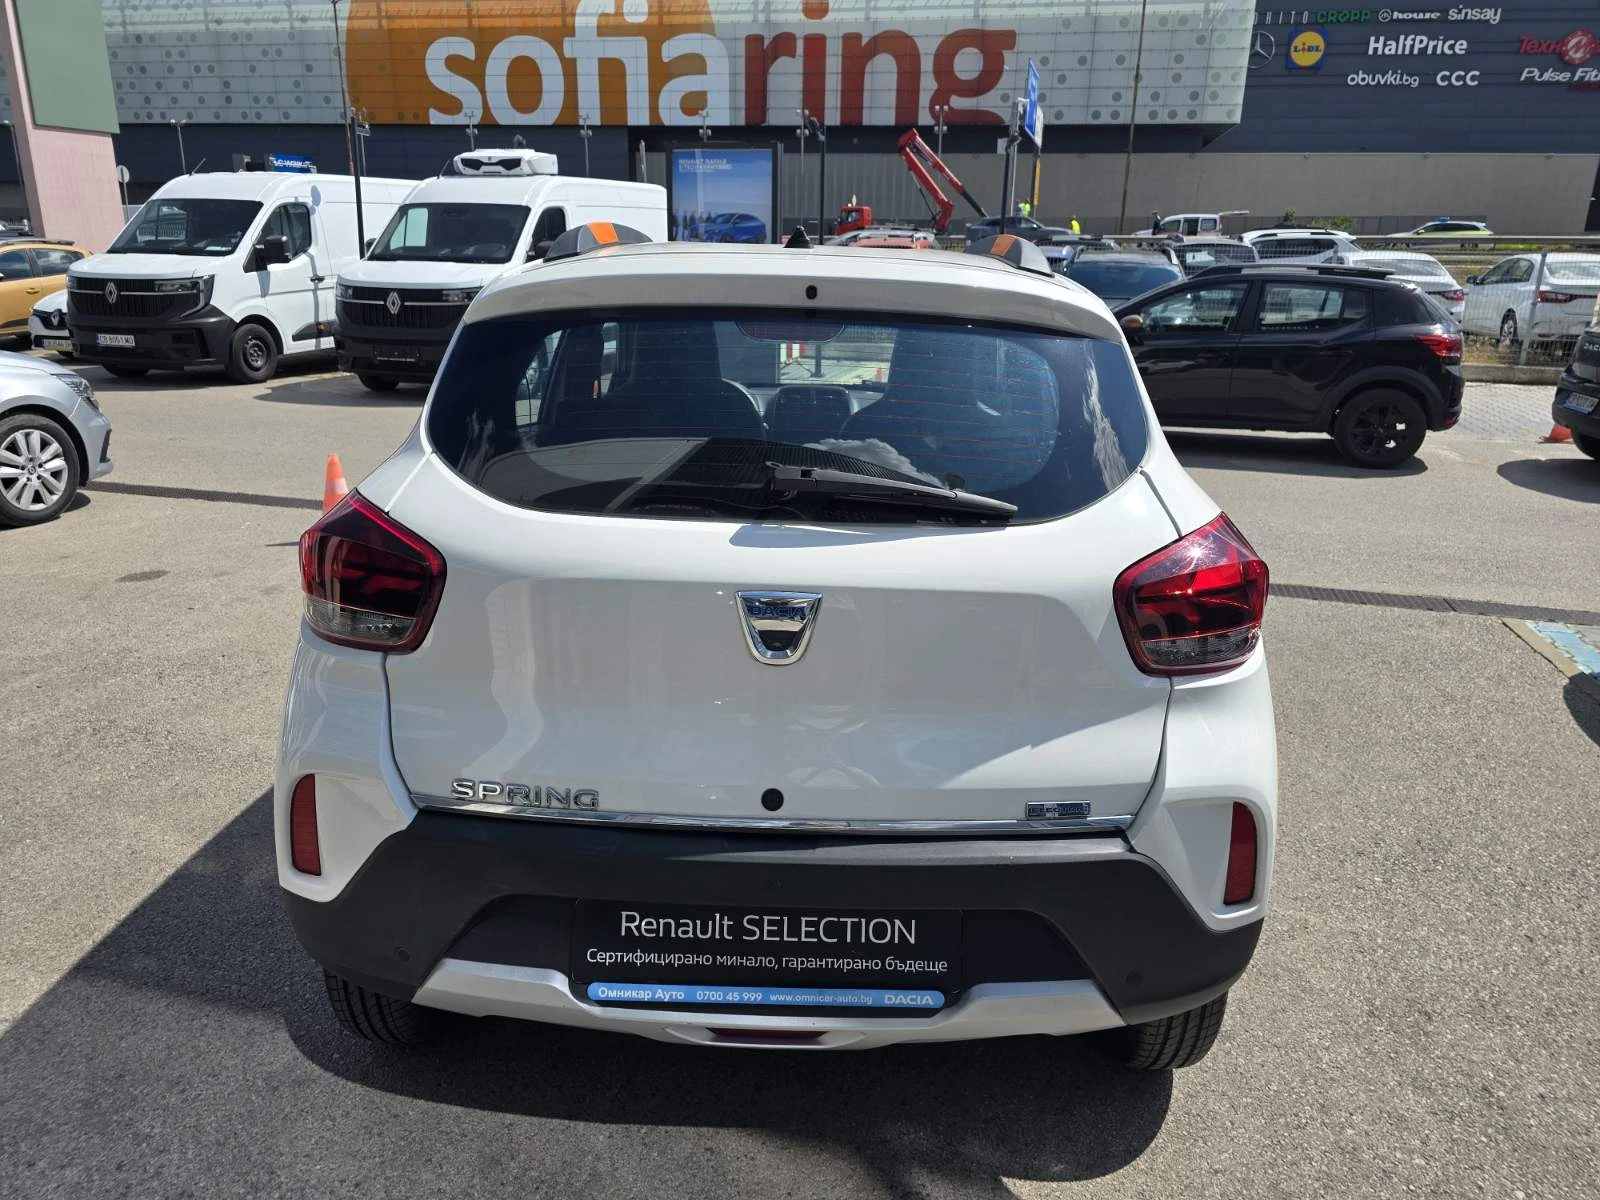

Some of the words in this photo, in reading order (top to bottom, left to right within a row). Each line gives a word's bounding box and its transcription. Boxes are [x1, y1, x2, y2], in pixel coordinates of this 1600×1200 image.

[1317, 10, 1370, 24] CROPP
[1447, 4, 1502, 25] sinsay
[1367, 34, 1468, 56] HalfPrice
[1347, 69, 1420, 88] obuvki.bg
[1436, 70, 1480, 87] CCC
[1520, 67, 1572, 82] Pulse
[1573, 67, 1600, 82] Fit
[451, 777, 600, 811] SPRING
[620, 911, 734, 940] Renault
[742, 914, 916, 945] SELECTION
[586, 948, 713, 967] Сертифицирано
[716, 955, 778, 970] минало,
[782, 956, 882, 973] гарантирано
[885, 956, 948, 974] бъдеще
[598, 986, 652, 1001] Омникар
[655, 990, 685, 1003] Ауто
[696, 991, 723, 1002] 0700
[725, 991, 740, 1002] 45
[742, 992, 763, 1002] 999
[769, 992, 873, 1004] www.omnicar-auto.bg
[884, 994, 934, 1005] DACIA
